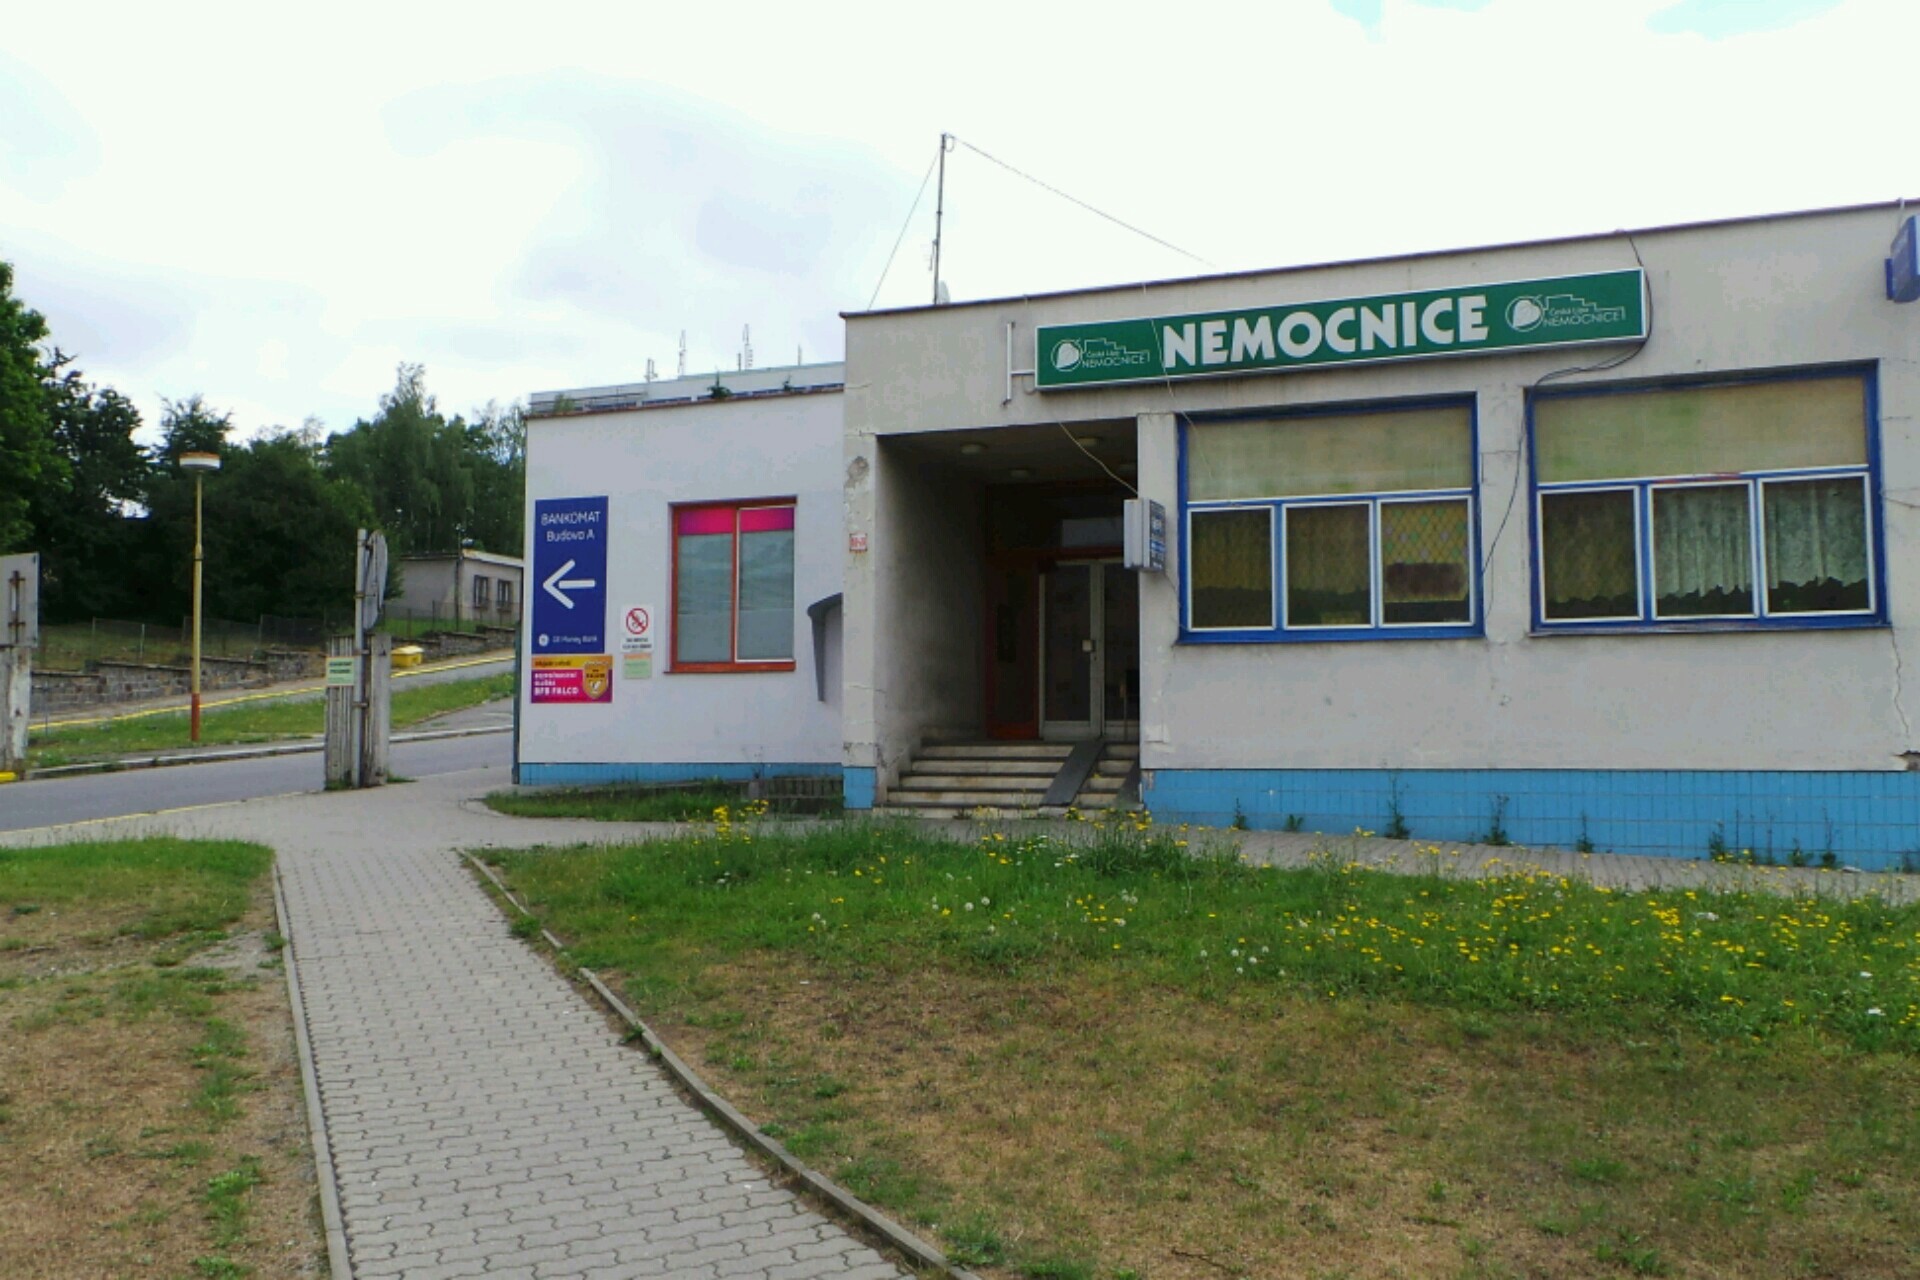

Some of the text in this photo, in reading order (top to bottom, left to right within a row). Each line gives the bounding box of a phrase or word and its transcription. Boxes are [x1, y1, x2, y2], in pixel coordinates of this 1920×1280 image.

[1543, 311, 1621, 327] NEMOCNICE
[1163, 294, 1489, 369] NEMOCNICE
[1082, 355, 1145, 368] NEMOCNICE
[541, 511, 601, 526] BANKOMAT
[586, 528, 595, 540] A
